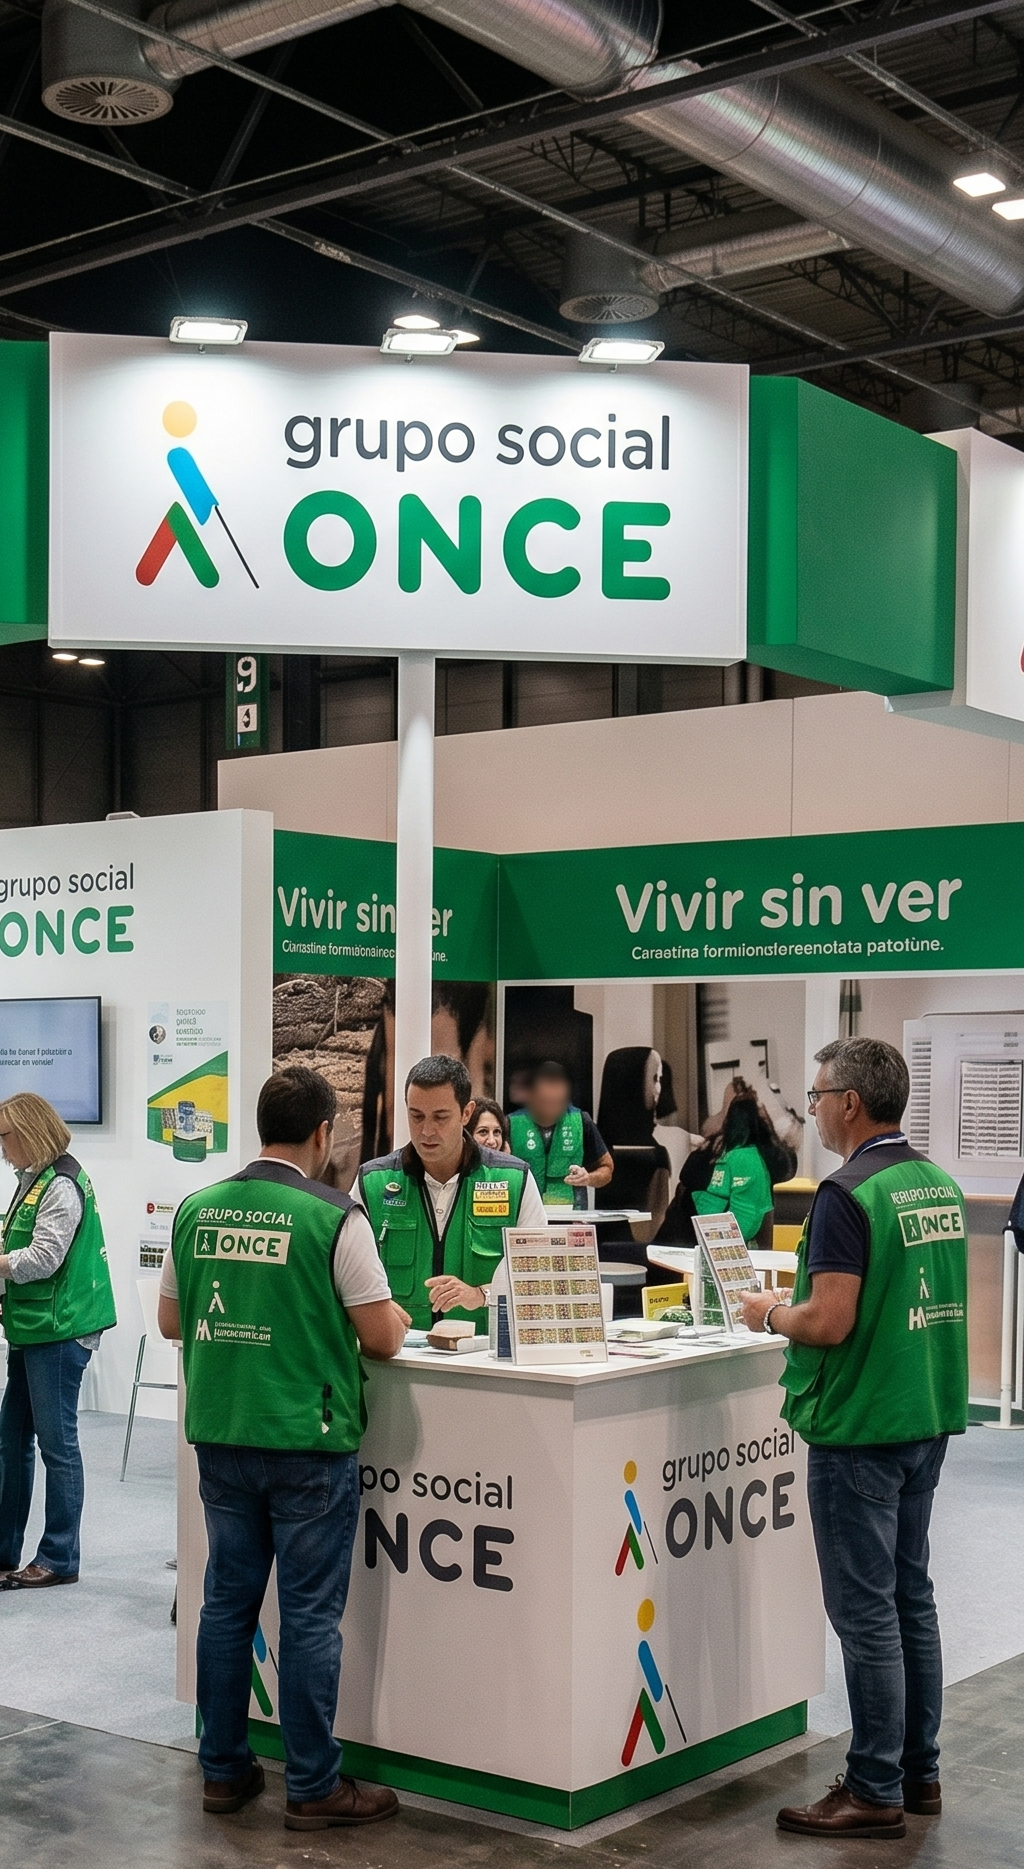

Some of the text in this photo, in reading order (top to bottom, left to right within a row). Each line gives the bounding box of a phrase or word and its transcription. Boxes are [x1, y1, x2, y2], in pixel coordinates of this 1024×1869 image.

[284, 413, 671, 473] grupo social
[283, 489, 671, 601] ONCE
[237, 656, 257, 693] 9
[68, 862, 134, 894] social
[615, 872, 963, 933] Vivir sin ver
[277, 886, 453, 937] Vivir sin er
[198, 1208, 294, 1226] GRUPO SOCIAL
[220, 1234, 282, 1257] ONCE
[662, 1428, 795, 1492] grupo social
[412, 1472, 513, 1510] social
[665, 1471, 795, 1559] ONCE
[364, 1508, 515, 1592] NCE
